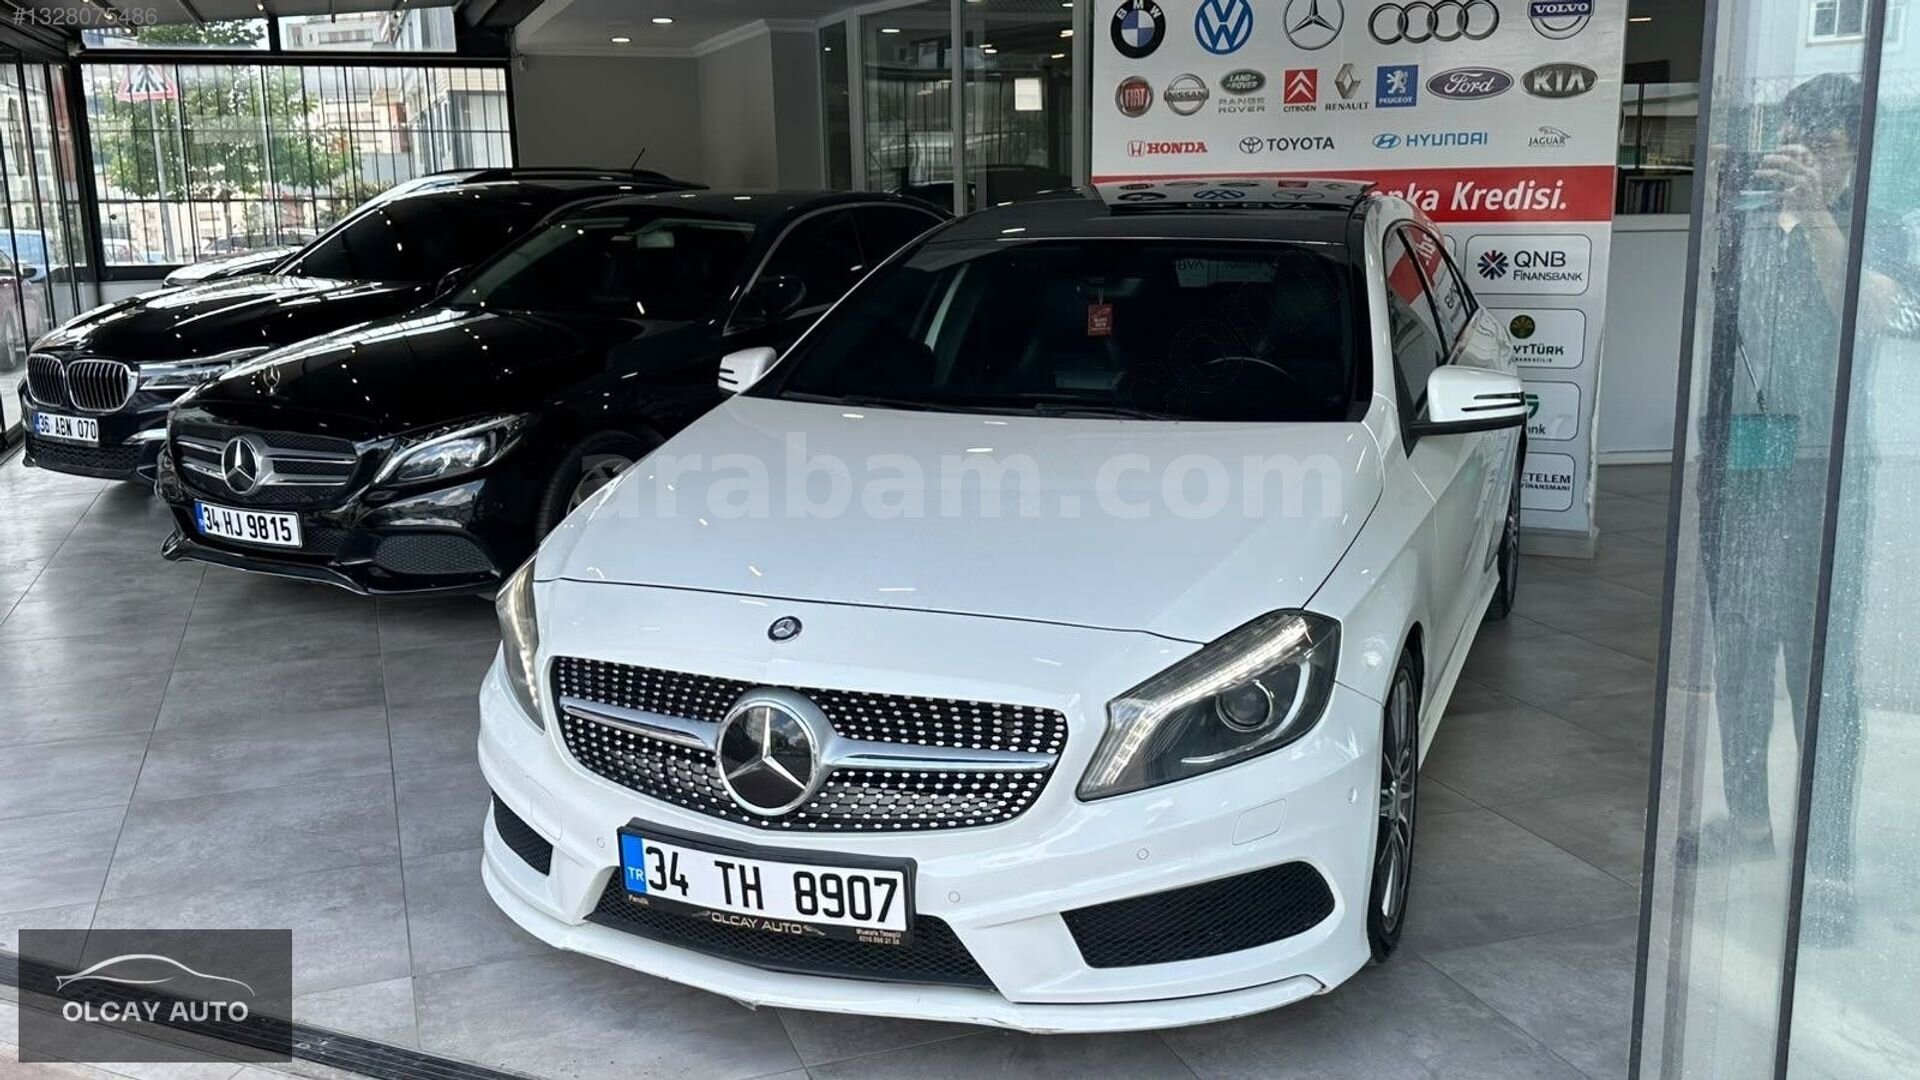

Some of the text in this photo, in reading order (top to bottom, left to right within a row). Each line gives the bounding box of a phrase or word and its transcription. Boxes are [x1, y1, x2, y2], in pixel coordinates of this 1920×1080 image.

[1533, 2, 1589, 14] VOLVO
[1444, 72, 1495, 94] Ford
[1533, 70, 1586, 92] KIA
[1125, 88, 1147, 107] FIAT
[1168, 91, 1204, 100] NISSAN
[1218, 97, 1265, 106] RANGE
[1218, 106, 1265, 114] ROVER
[1325, 102, 1369, 111] RENAULT
[1146, 141, 1208, 154] HONDA
[1267, 137, 1335, 151] TOYOTA
[1406, 132, 1488, 147] HYUNDAI
[1528, 136, 1566, 147] JAGUAR
[1450, 179, 1567, 211] Kredisi.
[1514, 251, 1566, 268] QNB
[39, 415, 51, 433] 36
[77, 420, 97, 440] 070
[203, 506, 293, 542] 34 HJ 9815
[627, 866, 645, 882] TR
[645, 845, 898, 923] 34 TH 8907
[711, 911, 802, 935] OLCAY AUTO
